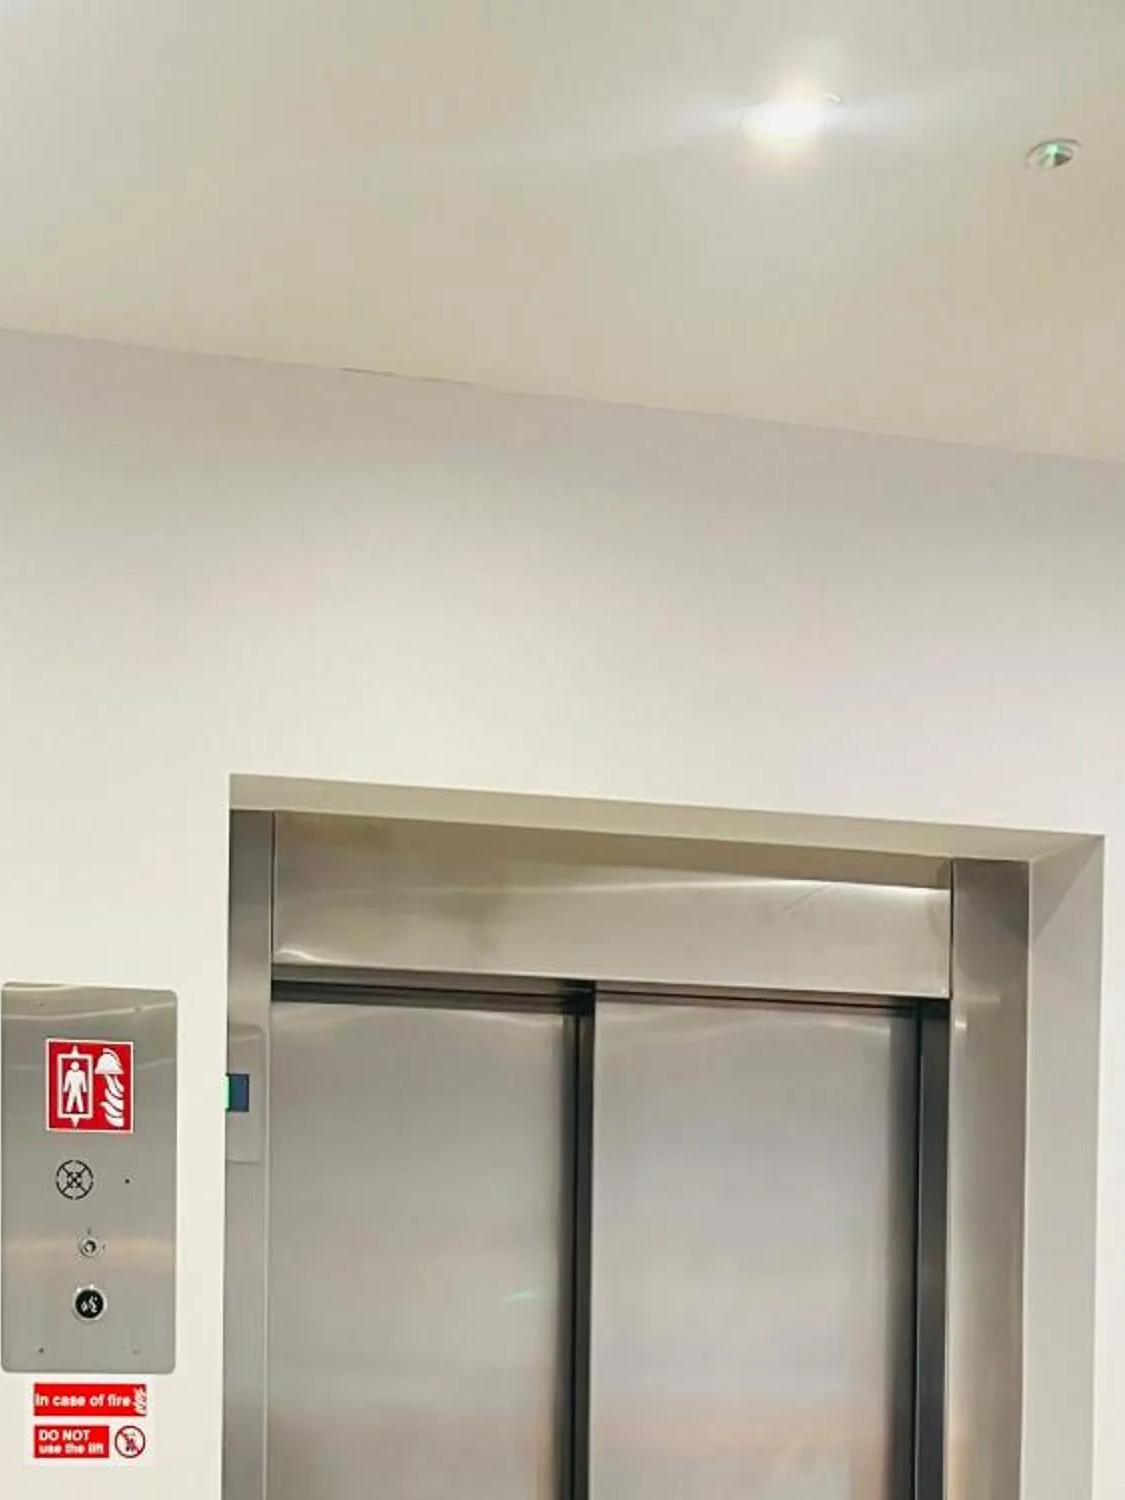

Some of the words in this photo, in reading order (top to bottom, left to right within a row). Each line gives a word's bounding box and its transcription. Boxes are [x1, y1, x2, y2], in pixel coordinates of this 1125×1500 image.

[52, 1395, 86, 1407] case
[90, 1393, 105, 1407] of
[107, 1393, 132, 1407] fire
[38, 1429, 60, 1441] DO
[62, 1429, 91, 1441] NOT
[38, 1444, 62, 1454] use
[64, 1443, 85, 1454] the
[88, 1442, 104, 1454] lift
